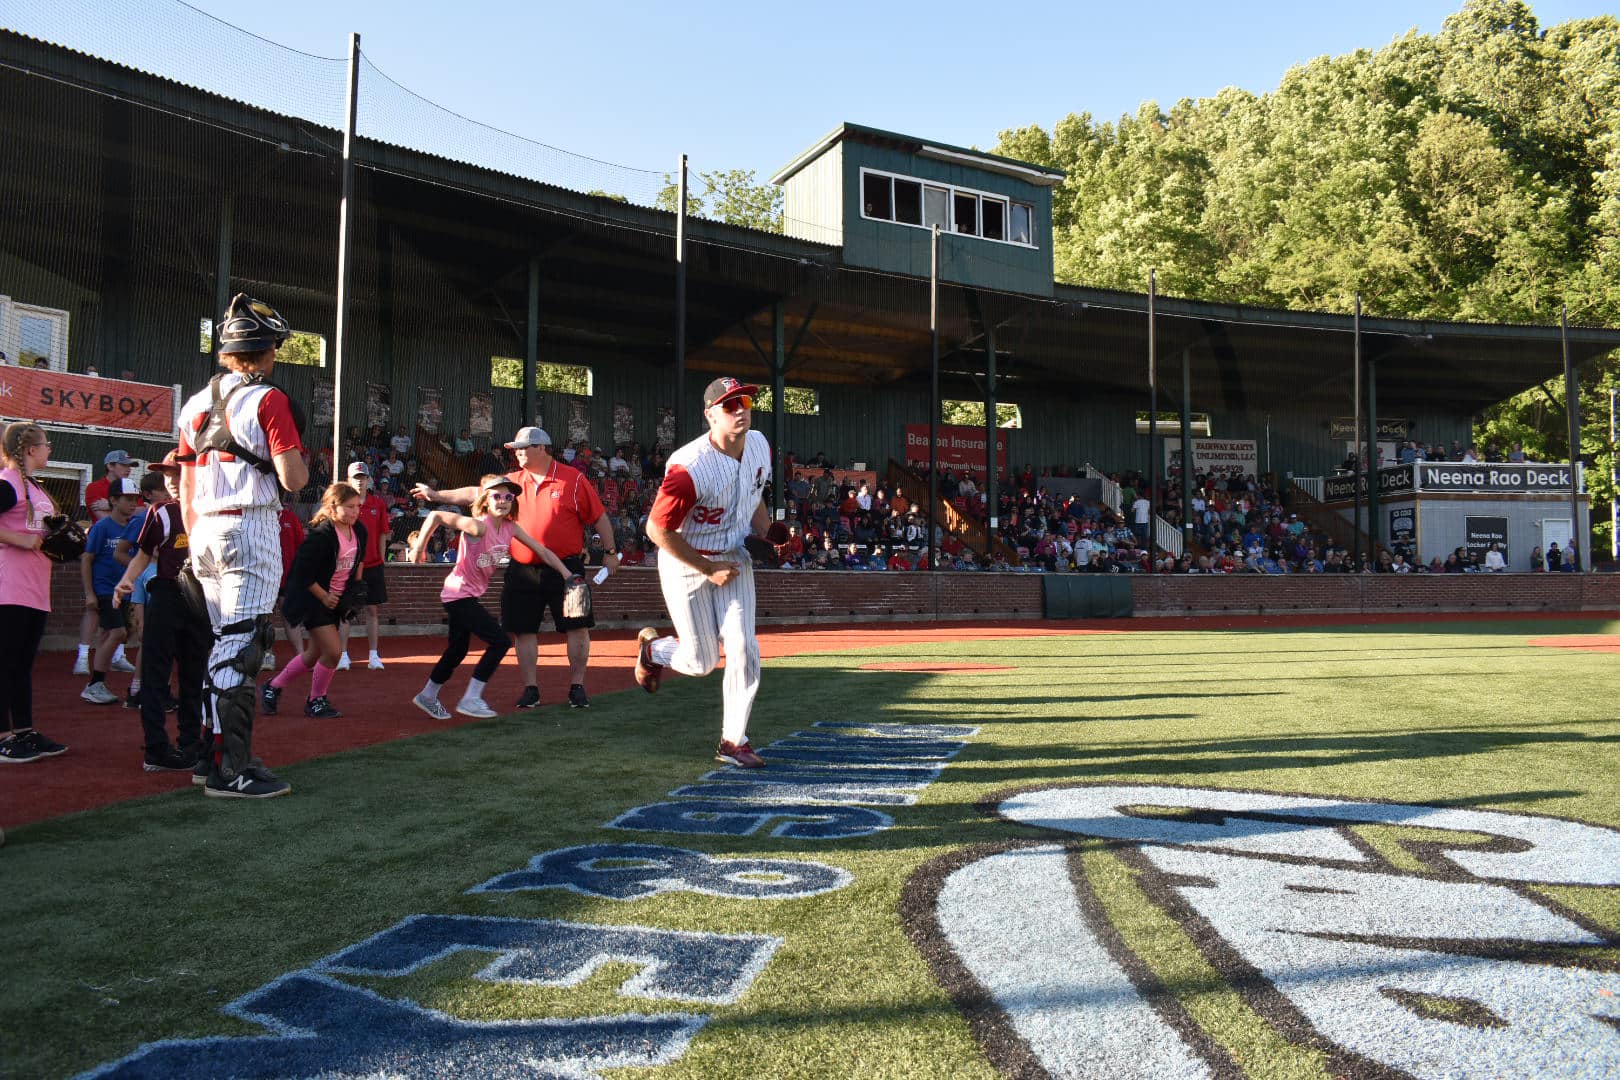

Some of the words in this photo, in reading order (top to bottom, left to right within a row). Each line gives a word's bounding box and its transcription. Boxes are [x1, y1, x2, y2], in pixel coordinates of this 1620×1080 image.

[40, 387, 153, 416] SKYBOX
[907, 432, 949, 448] Beaon
[1382, 469, 1410, 488] Deck
[1427, 468, 1484, 486] Neena
[1490, 470, 1521, 486] Rao
[1526, 469, 1570, 486] Deck
[693, 505, 725, 524] 32
